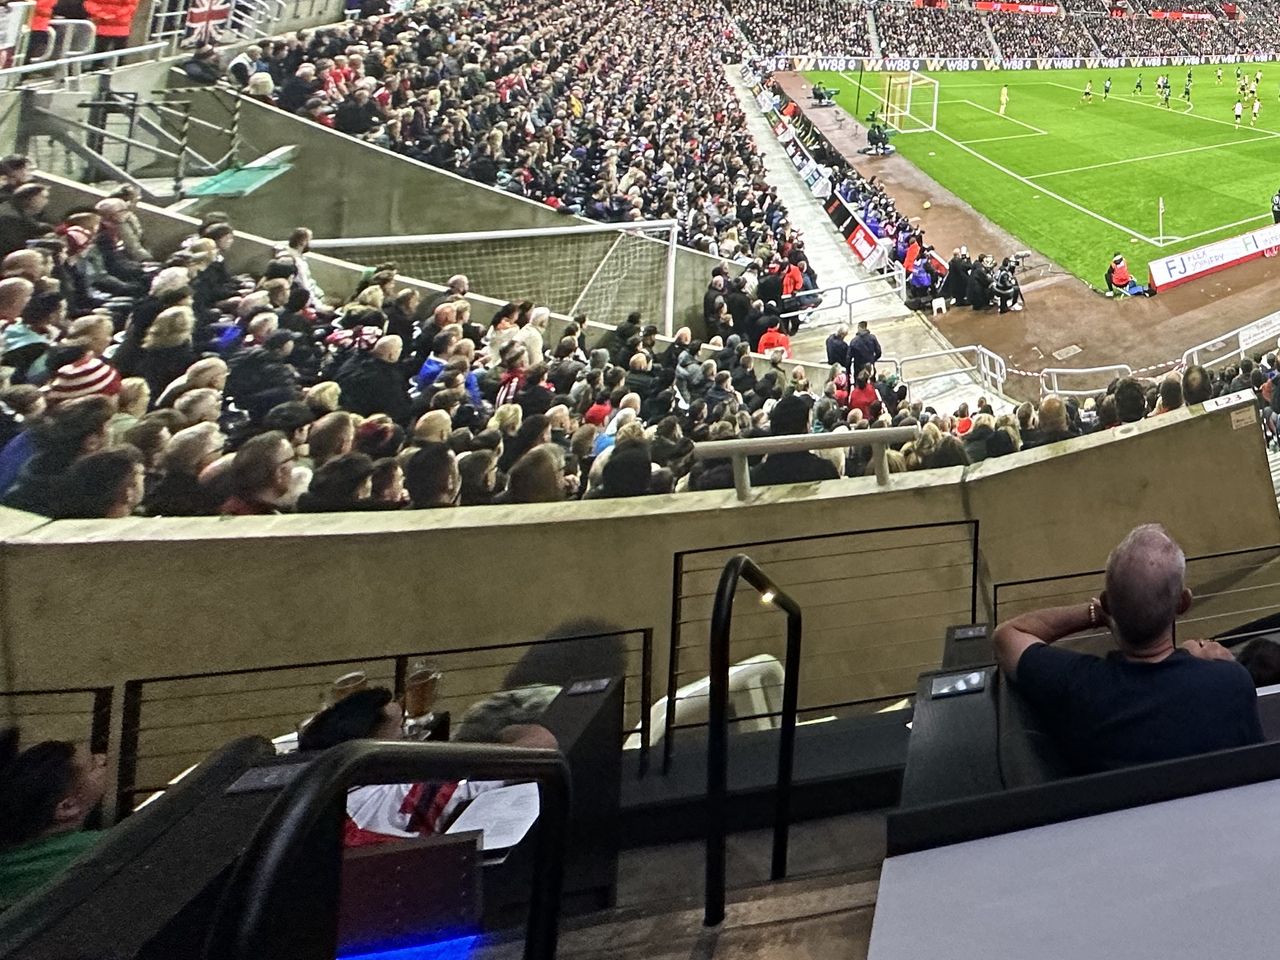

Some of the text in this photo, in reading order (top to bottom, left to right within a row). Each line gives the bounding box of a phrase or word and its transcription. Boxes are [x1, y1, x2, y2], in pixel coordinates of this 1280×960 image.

[817, 58, 846, 71] W88
[885, 58, 911, 71] W88
[946, 59, 969, 71] W88
[1002, 59, 1024, 70] W88
[1165, 257, 1187, 279] FJ
